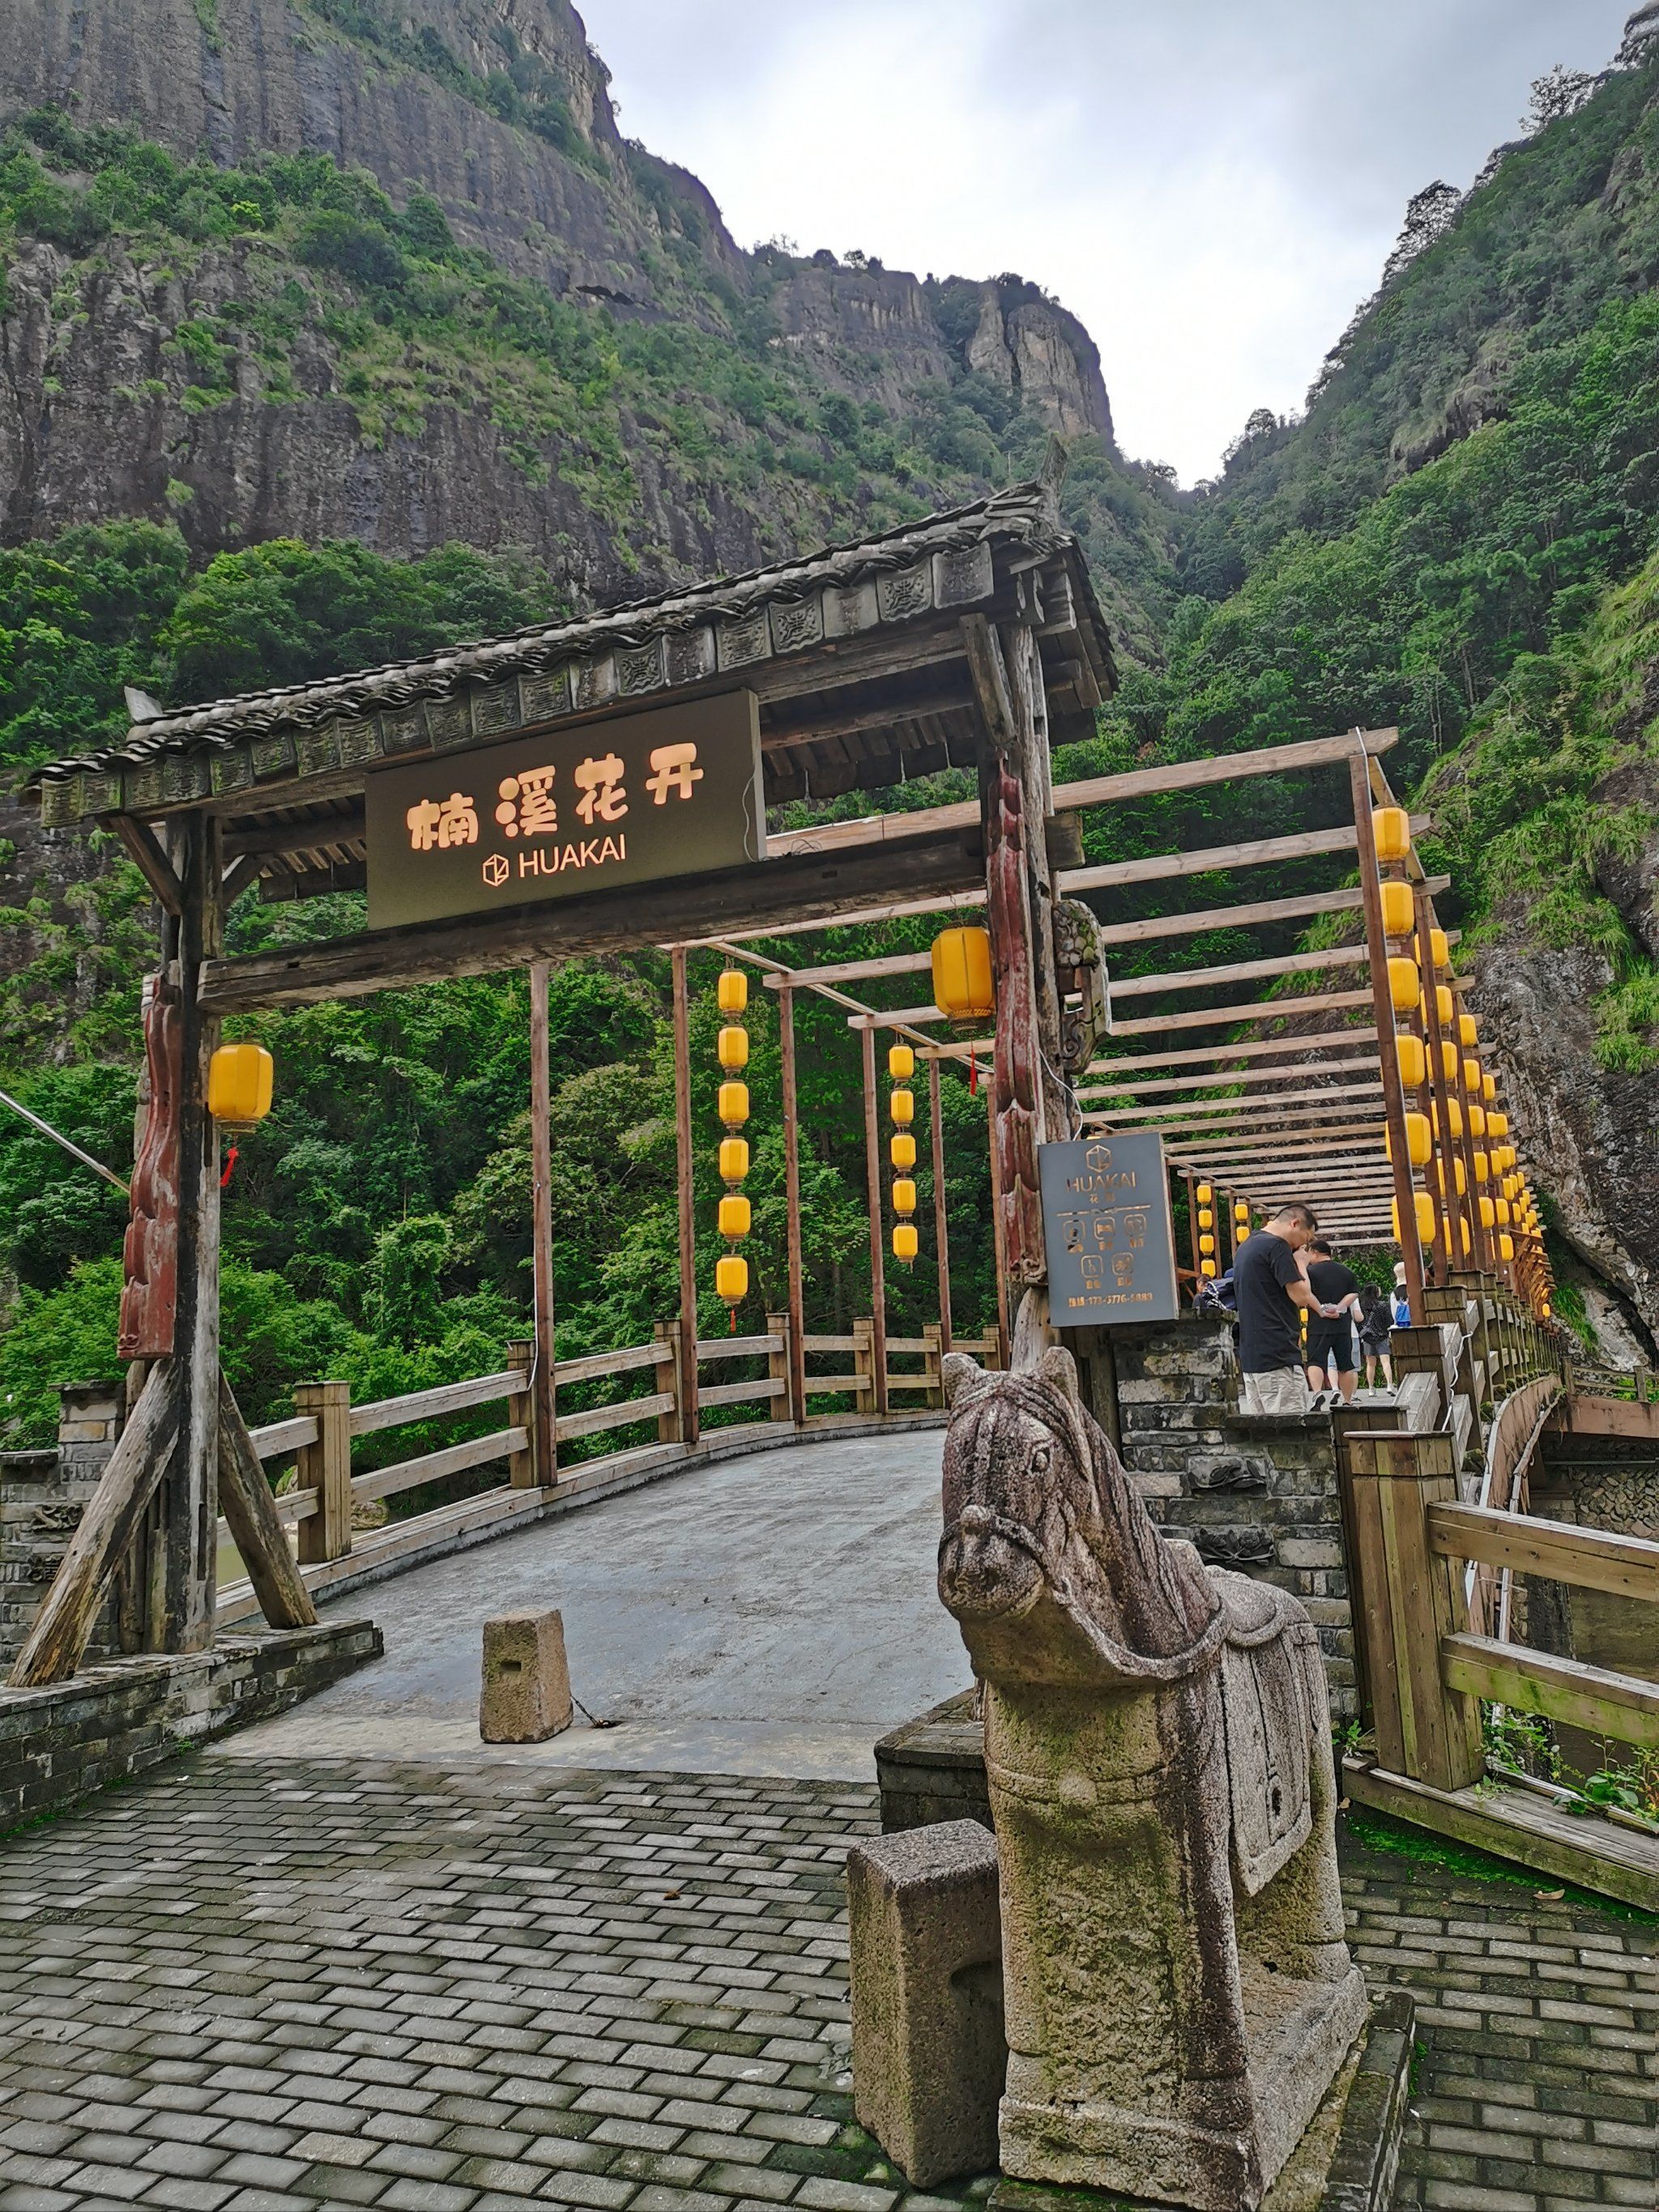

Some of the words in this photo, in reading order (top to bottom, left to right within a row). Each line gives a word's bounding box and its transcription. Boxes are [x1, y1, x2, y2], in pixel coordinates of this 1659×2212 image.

[407, 742, 704, 850] 楠溪花开
[518, 833, 627, 878] HUAKAI
[1066, 1171, 1137, 1193] HUAKAI
